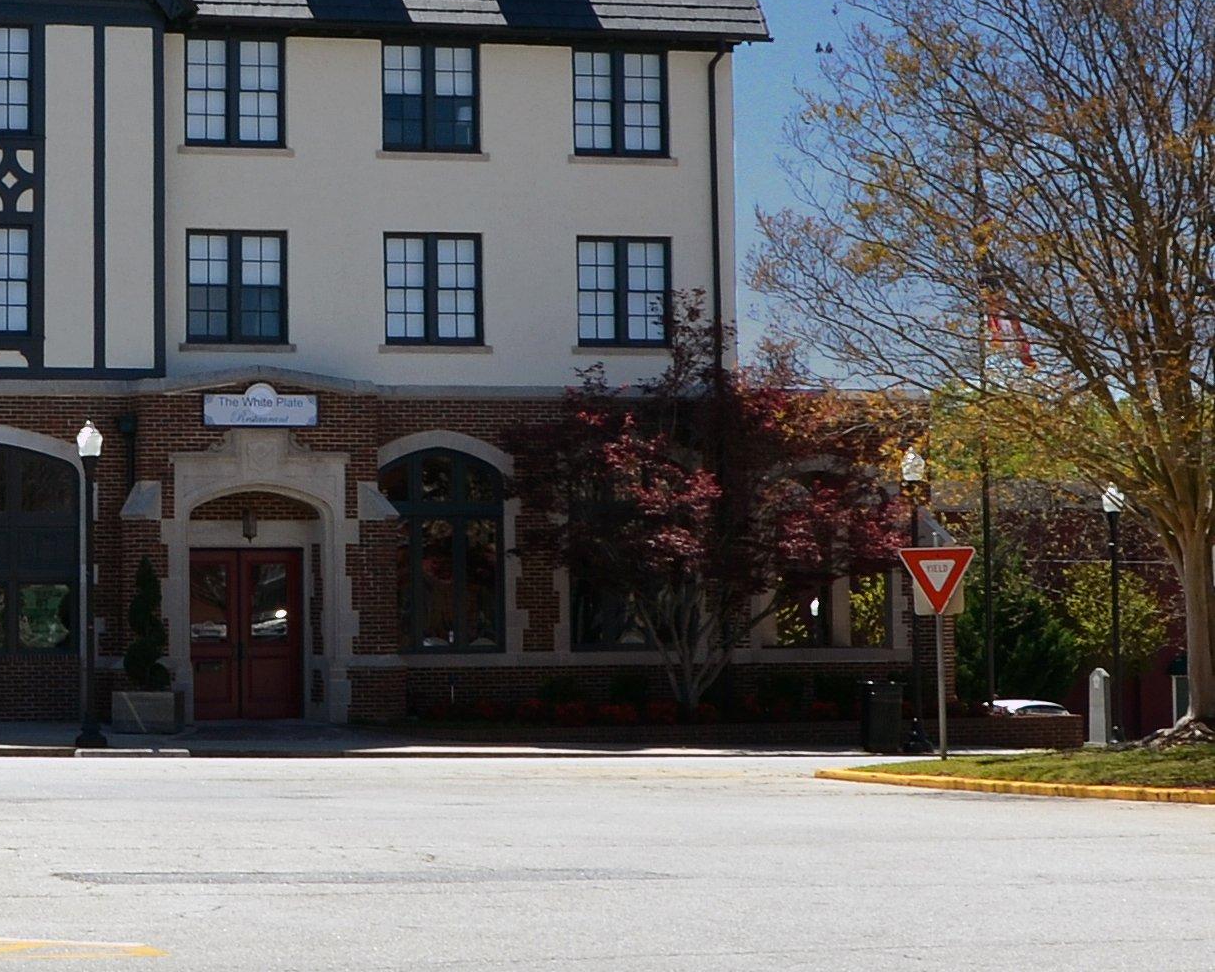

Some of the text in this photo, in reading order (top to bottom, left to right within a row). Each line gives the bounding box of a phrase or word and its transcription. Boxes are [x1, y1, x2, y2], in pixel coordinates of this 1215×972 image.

[218, 397, 304, 408] The White Plate
[927, 564, 948, 573] YIELD
